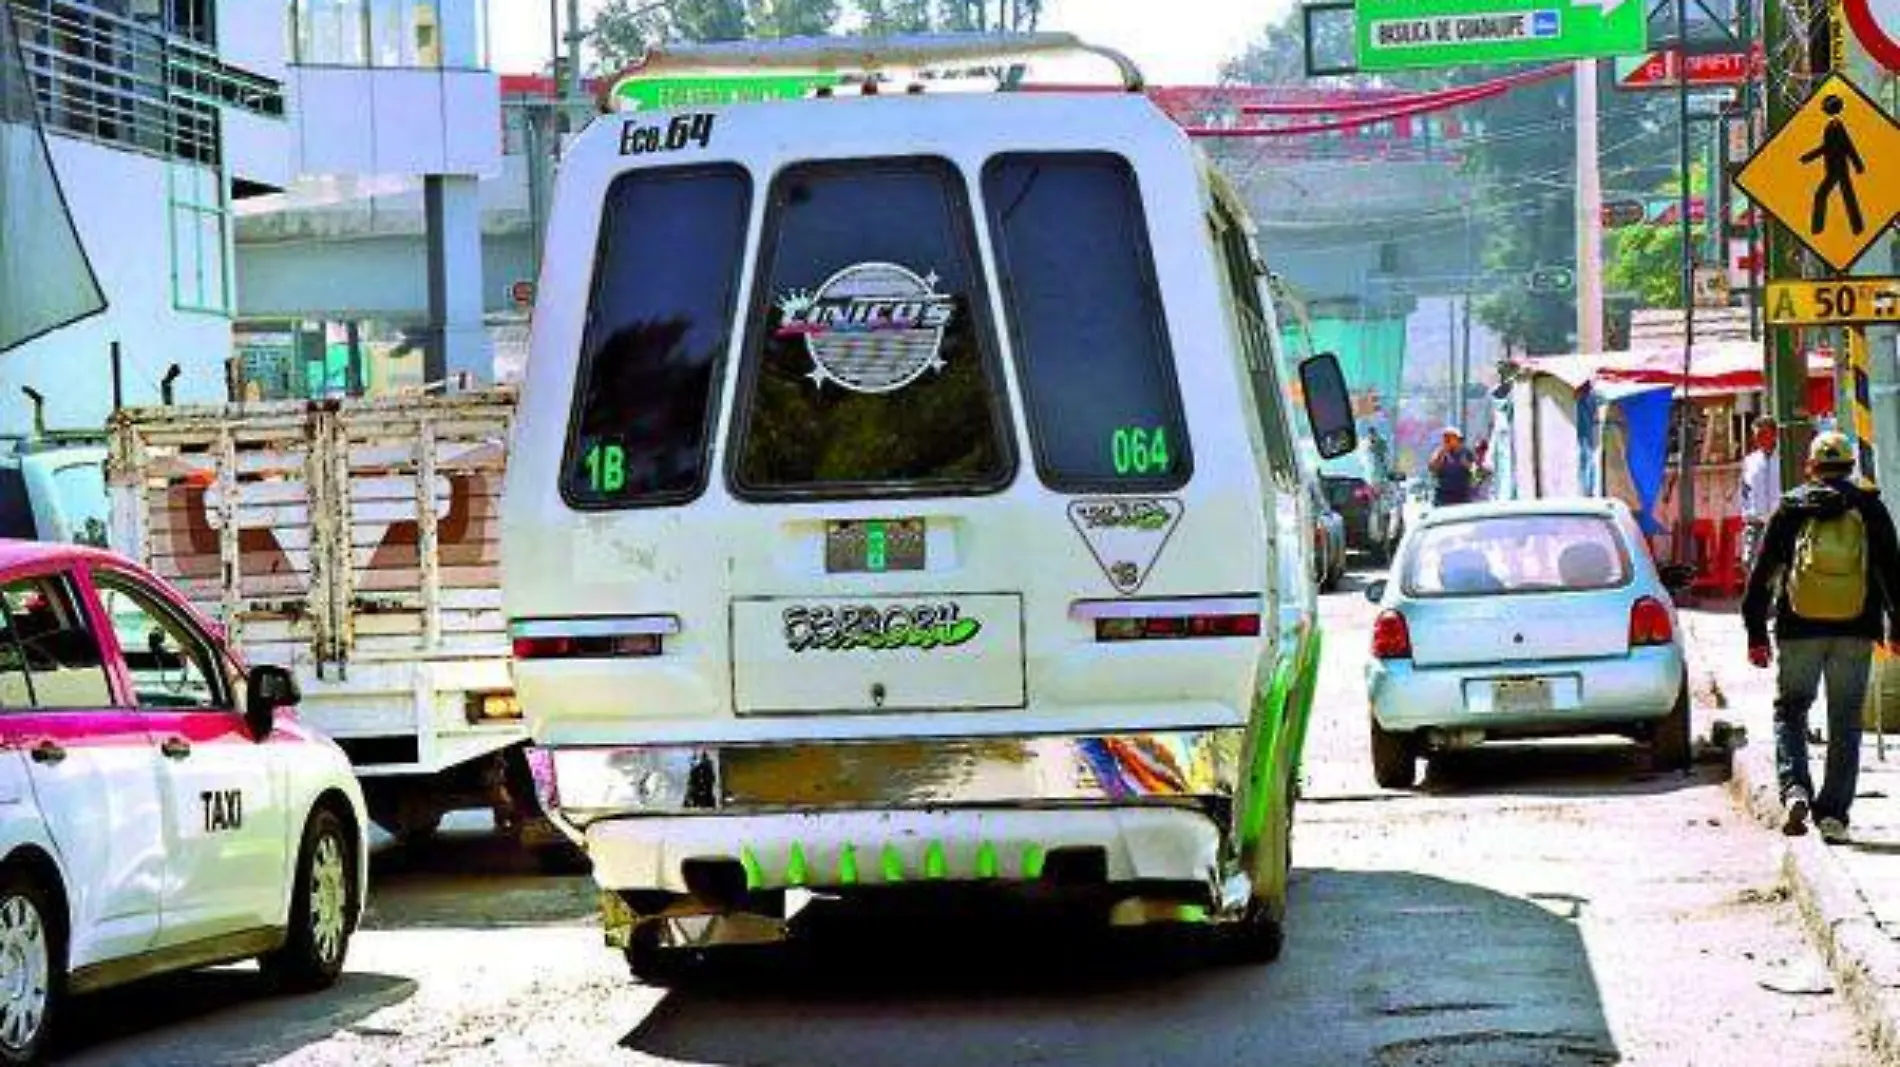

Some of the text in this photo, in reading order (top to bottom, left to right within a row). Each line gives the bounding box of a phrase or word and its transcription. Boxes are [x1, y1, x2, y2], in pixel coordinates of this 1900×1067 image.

[1435, 19, 1451, 41] DE
[1772, 284, 1857, 319] A 50
[583, 445, 626, 493] 1B
[1112, 427, 1169, 474] 064
[199, 788, 243, 832] TAXI
